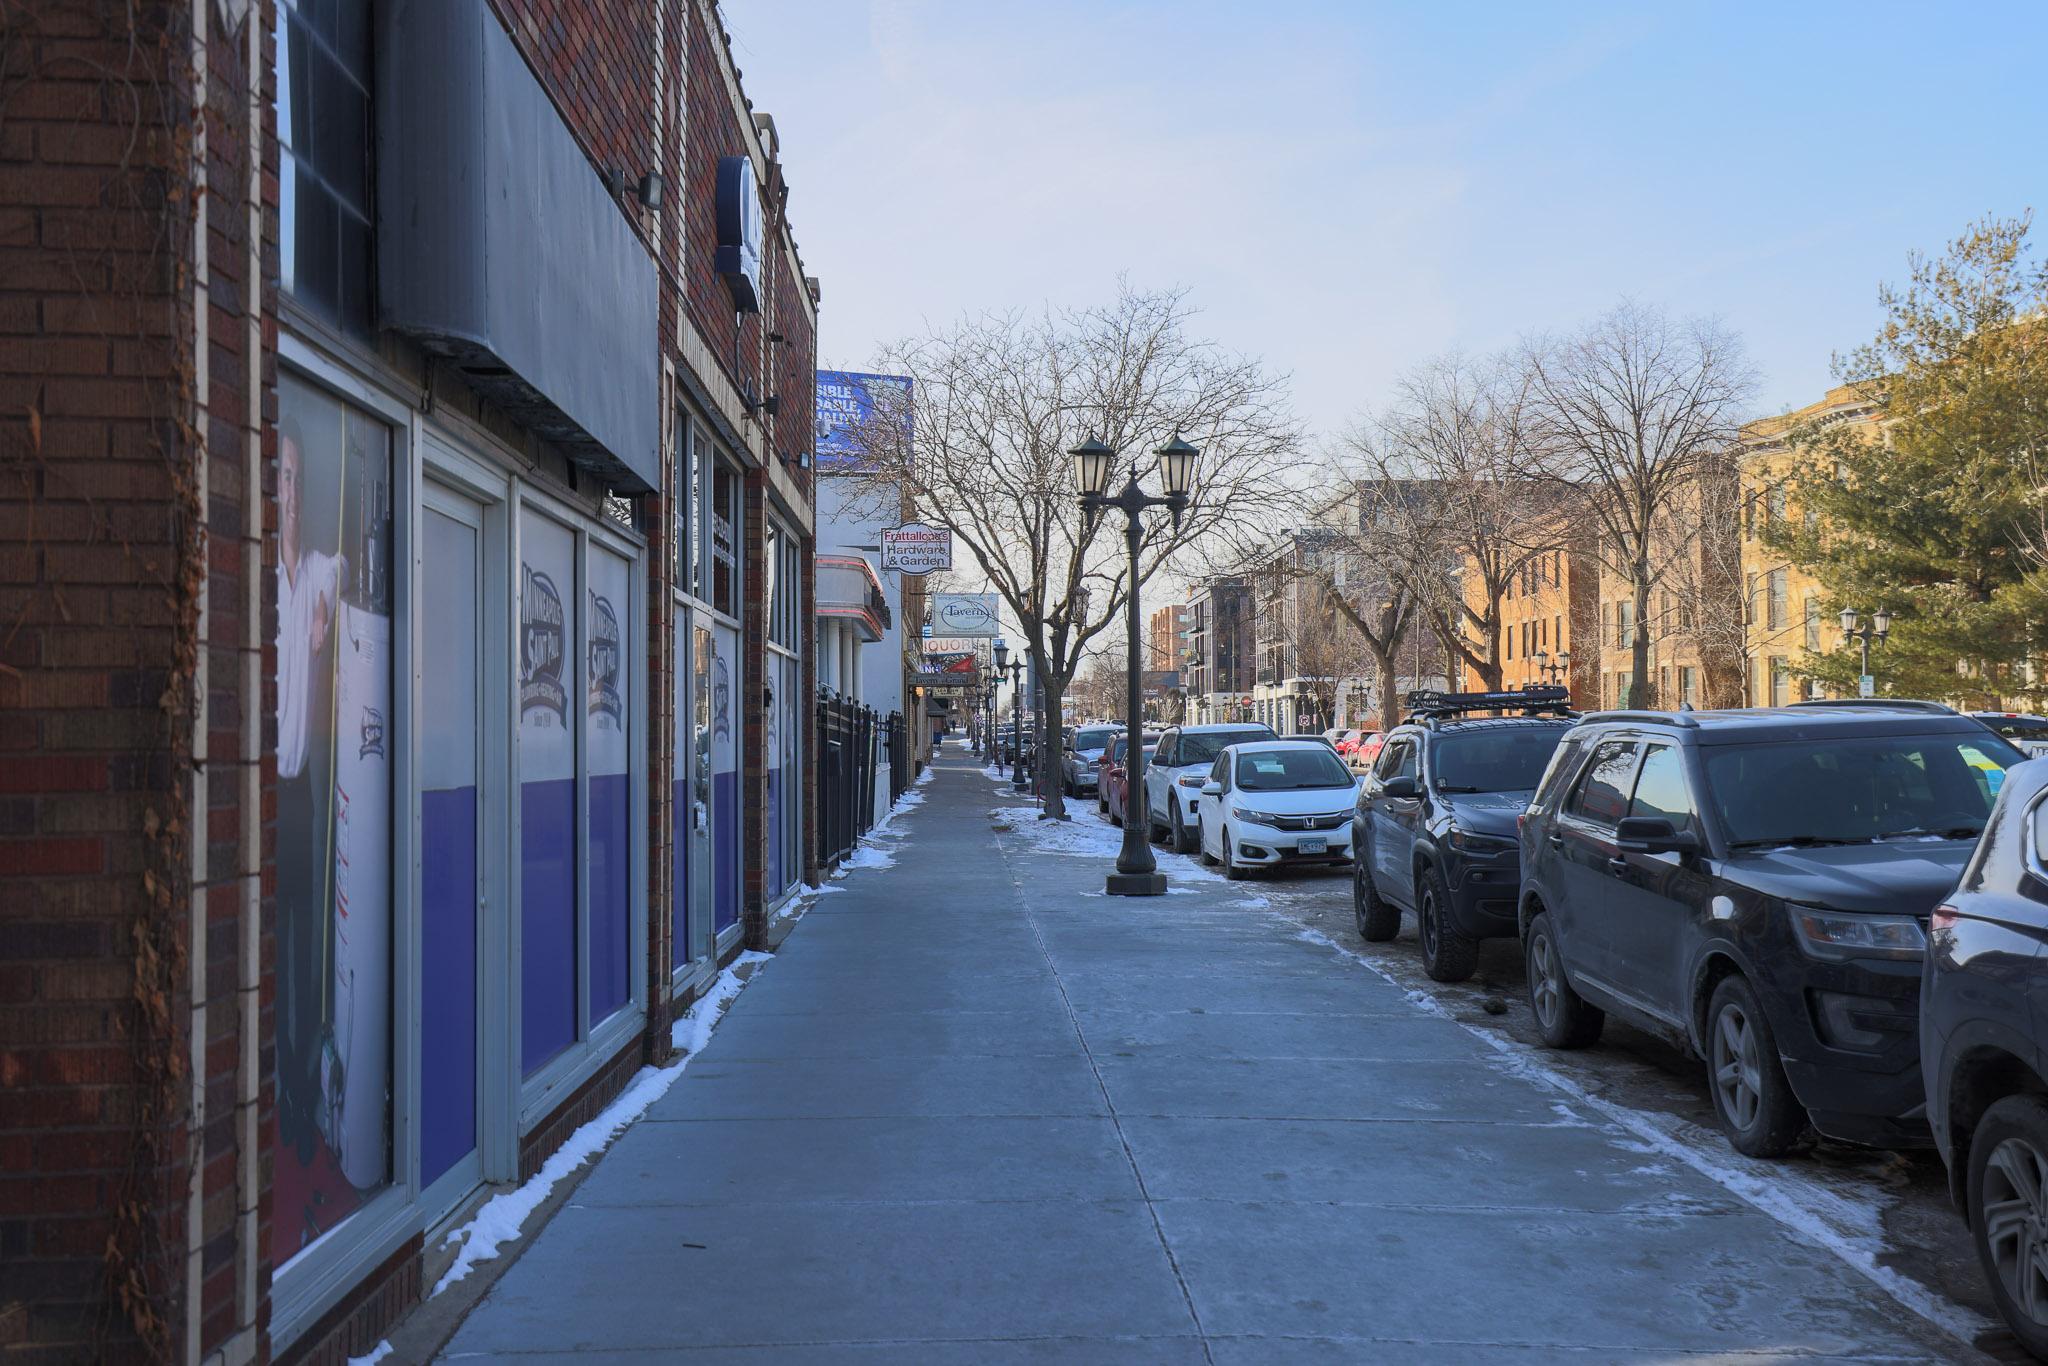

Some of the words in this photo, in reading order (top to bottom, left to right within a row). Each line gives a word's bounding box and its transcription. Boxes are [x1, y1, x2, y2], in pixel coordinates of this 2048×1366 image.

[887, 545, 946, 555] Hardware
[888, 556, 898, 566] &
[900, 556, 945, 566] Garden
[945, 605, 986, 617] Tavern
